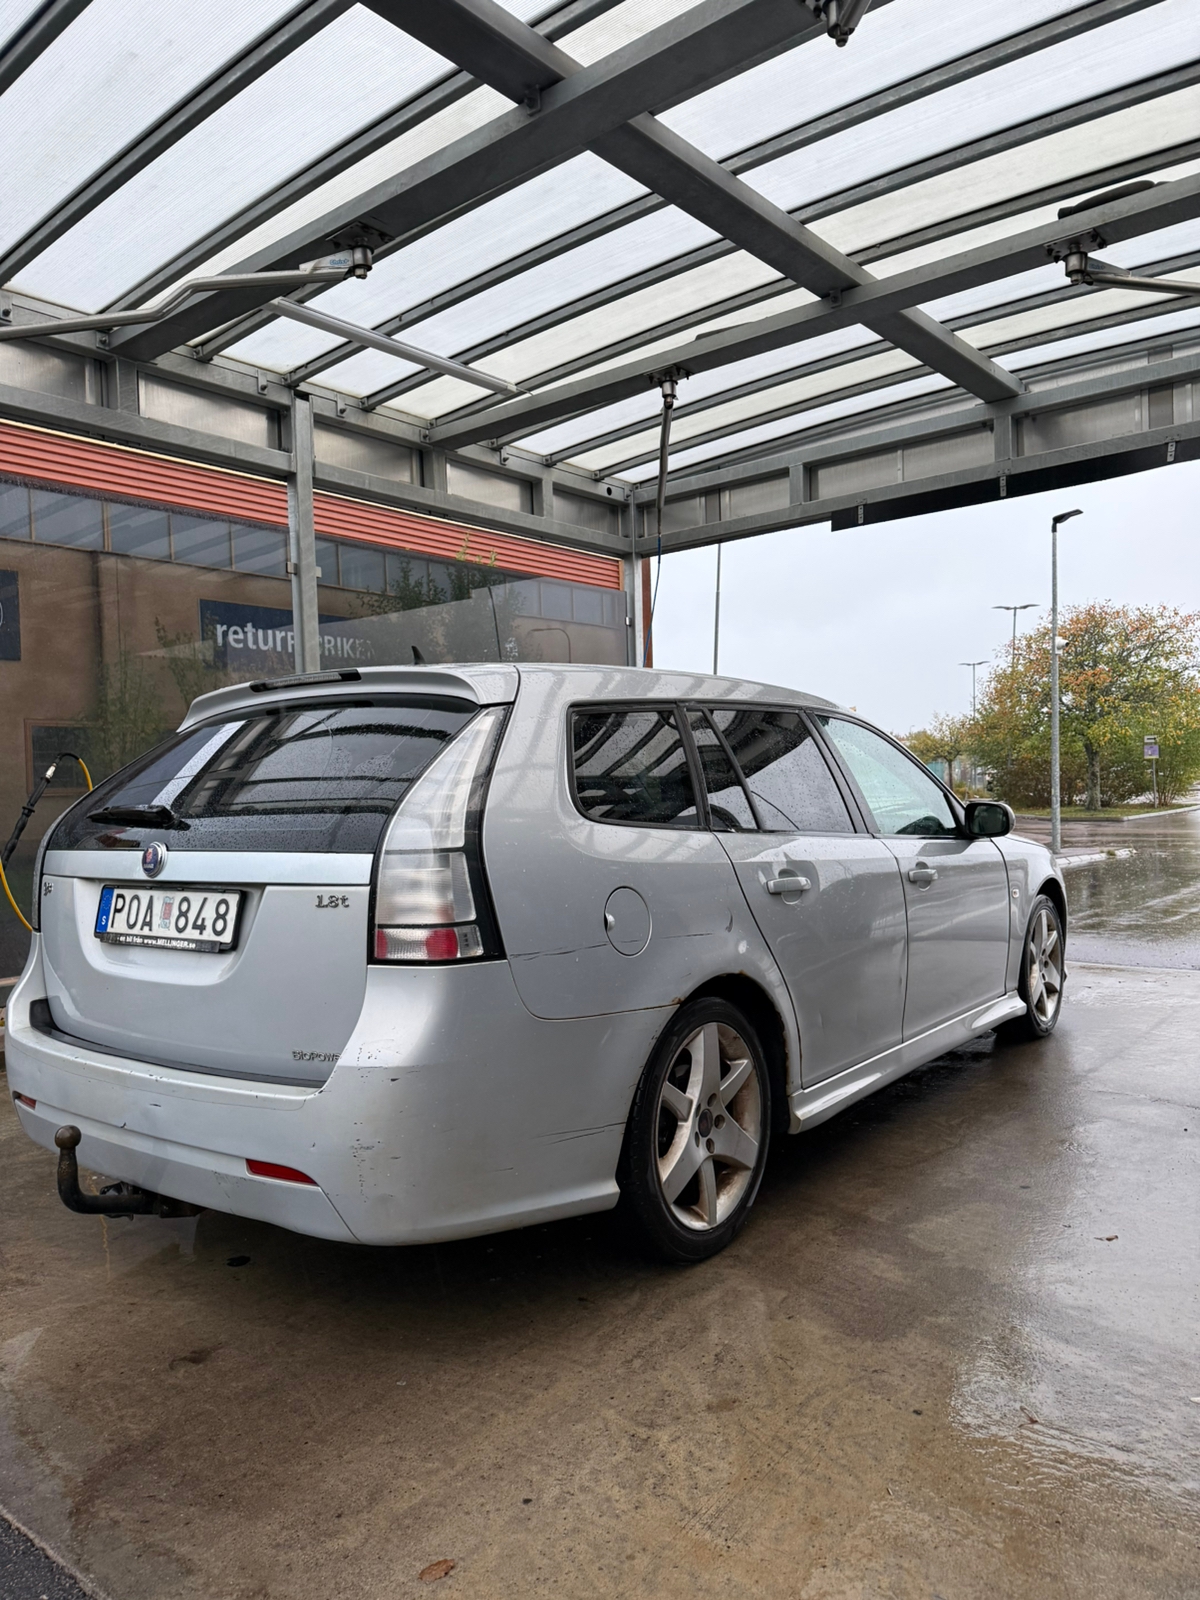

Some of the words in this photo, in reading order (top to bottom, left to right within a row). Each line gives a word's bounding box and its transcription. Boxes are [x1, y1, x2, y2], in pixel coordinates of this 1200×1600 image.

[101, 915, 107, 925] S
[110, 893, 153, 932] POA
[174, 896, 230, 937] 848
